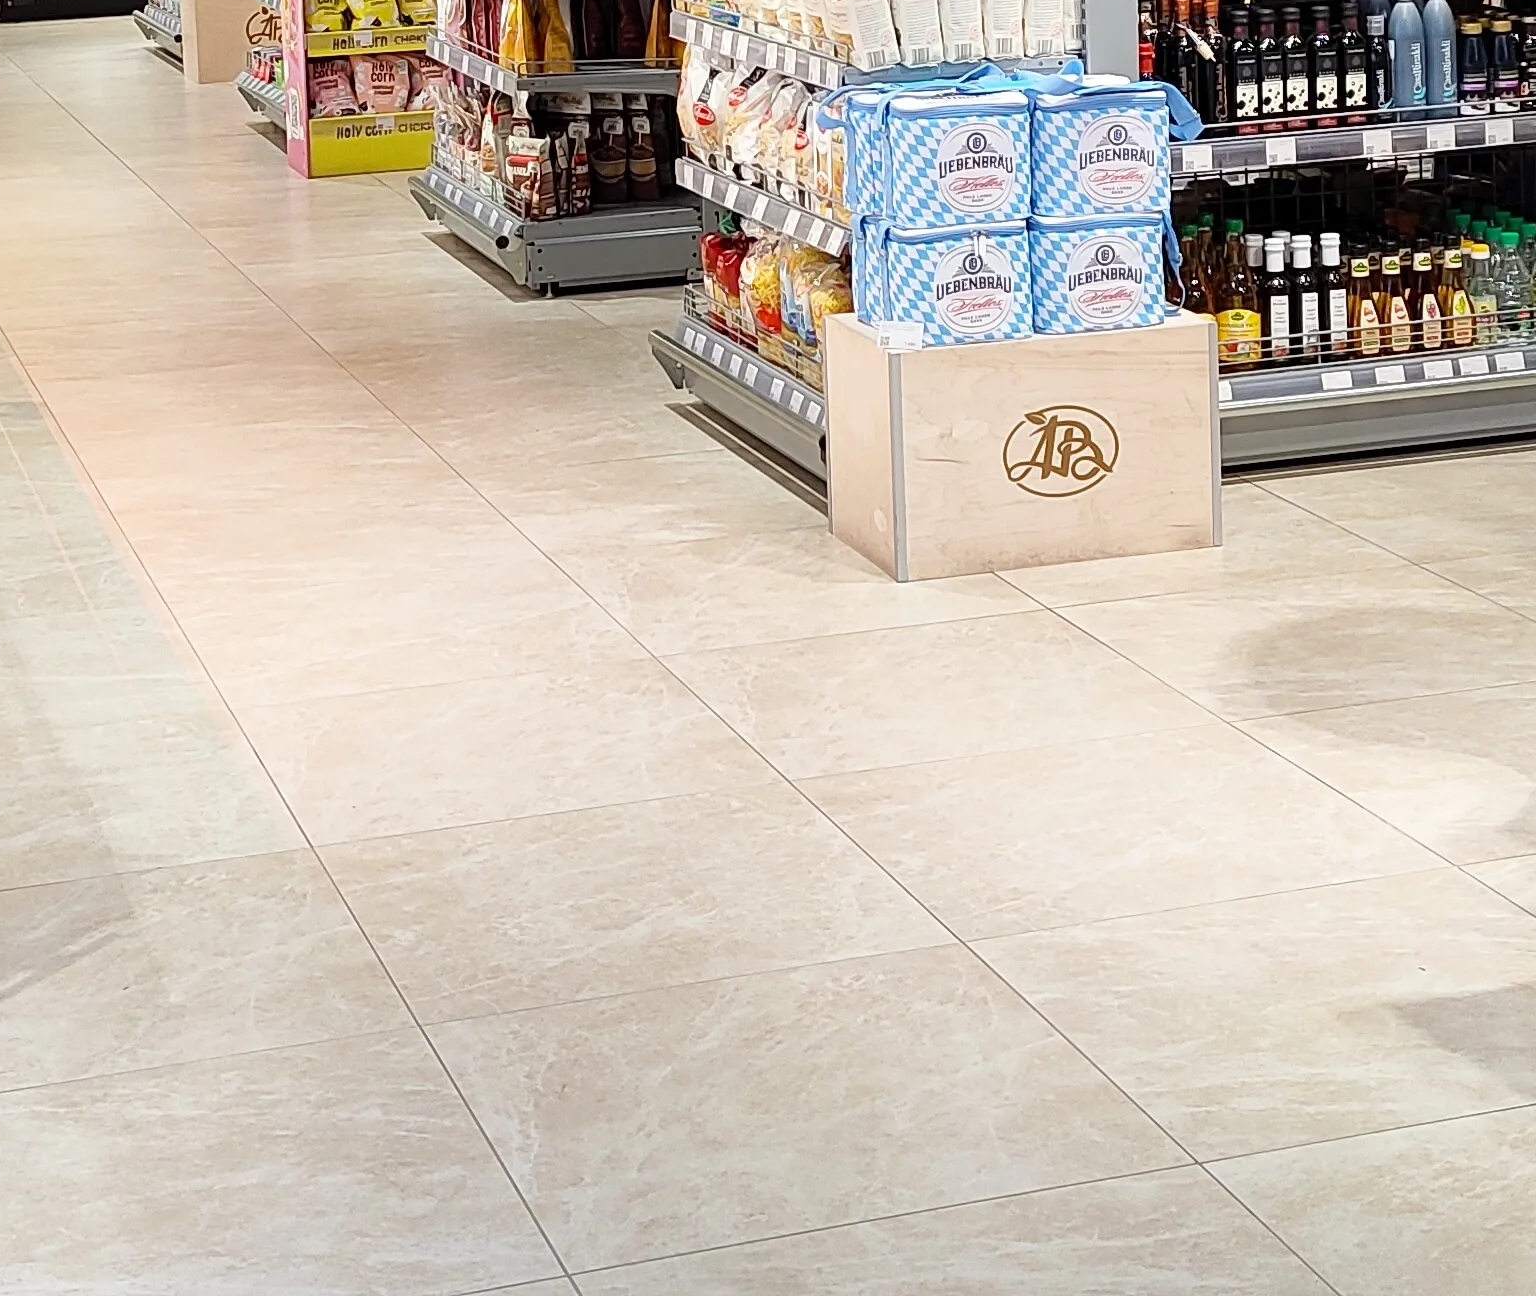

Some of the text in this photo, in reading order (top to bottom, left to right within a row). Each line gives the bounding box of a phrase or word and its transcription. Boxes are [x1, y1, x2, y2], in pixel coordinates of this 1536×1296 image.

[372, 61, 394, 73] Holy
[371, 72, 395, 83] corn
[337, 124, 362, 140] Holy
